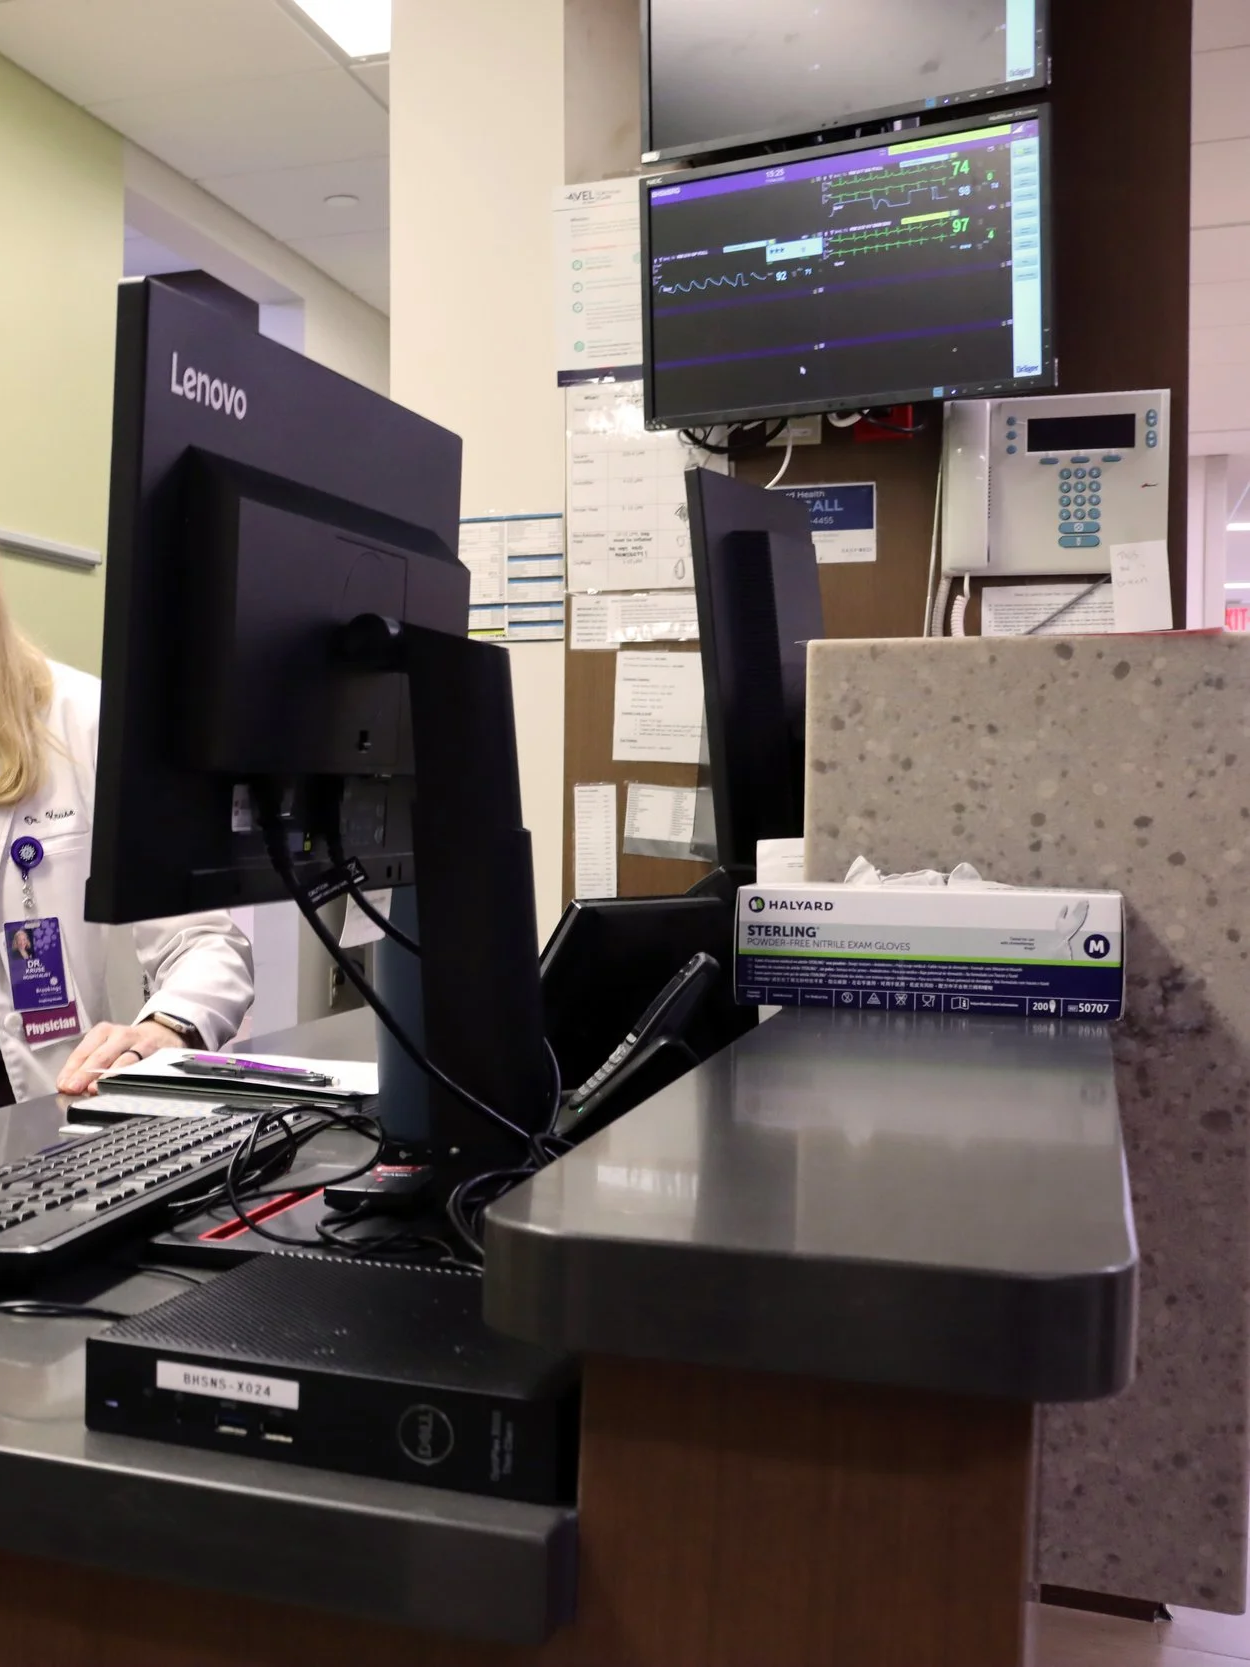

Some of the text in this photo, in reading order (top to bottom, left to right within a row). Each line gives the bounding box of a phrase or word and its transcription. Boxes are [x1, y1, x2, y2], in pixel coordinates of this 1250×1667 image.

[952, 160, 970, 177] 74
[952, 217, 970, 233] 97
[171, 351, 247, 420] Lenovo
[797, 491, 825, 499] Health
[808, 499, 844, 512] ALL
[769, 900, 834, 911] HALYARD
[747, 925, 818, 938] STERLING
[747, 938, 911, 951] POWDER-FREE NITRILE EXAM GLOVES
[1088, 940, 1104, 953] M
[23, 972, 51, 980] HOSPITALIST
[26, 966, 45, 974] KRUSE
[1033, 1002, 1048, 1011] 200
[1078, 1003, 1109, 1014] 50707
[25, 1016, 77, 1037] Physician
[183, 1372, 272, 1398] BHSNS-X024
